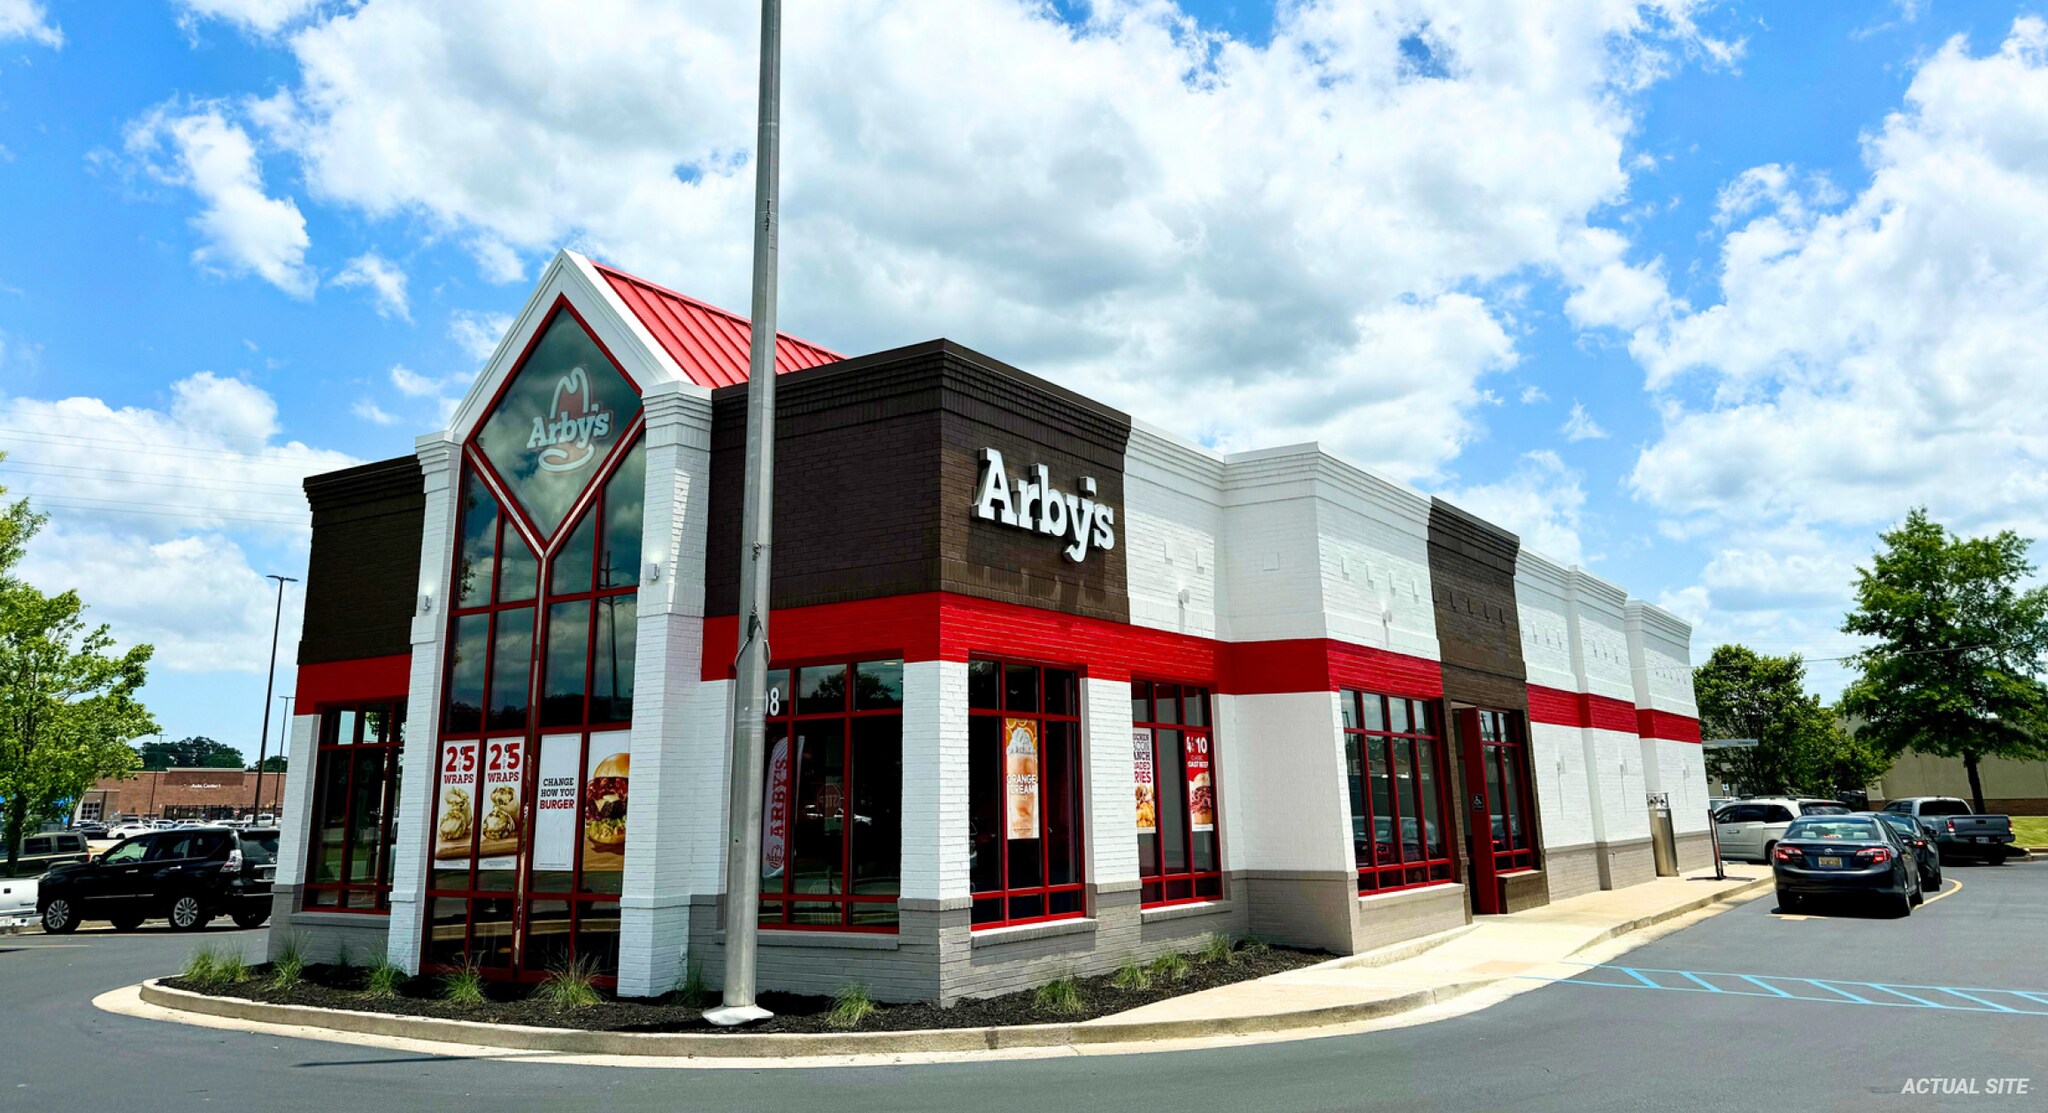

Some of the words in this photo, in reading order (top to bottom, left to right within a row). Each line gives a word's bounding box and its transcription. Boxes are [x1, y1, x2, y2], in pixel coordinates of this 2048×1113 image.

[527, 403, 610, 449] Arby's
[971, 447, 1115, 563] Arby's
[1133, 751, 1150, 760] ANCH
[444, 773, 474, 784] WRAPS
[488, 771, 519, 783] WRAPS
[543, 777, 575, 786] CHANGE
[1006, 774, 1037, 784] ORANGE
[1134, 771, 1152, 783] RIES
[541, 788, 558, 797] HOW
[560, 788, 575, 796] YOU
[540, 799, 575, 809] BURGER
